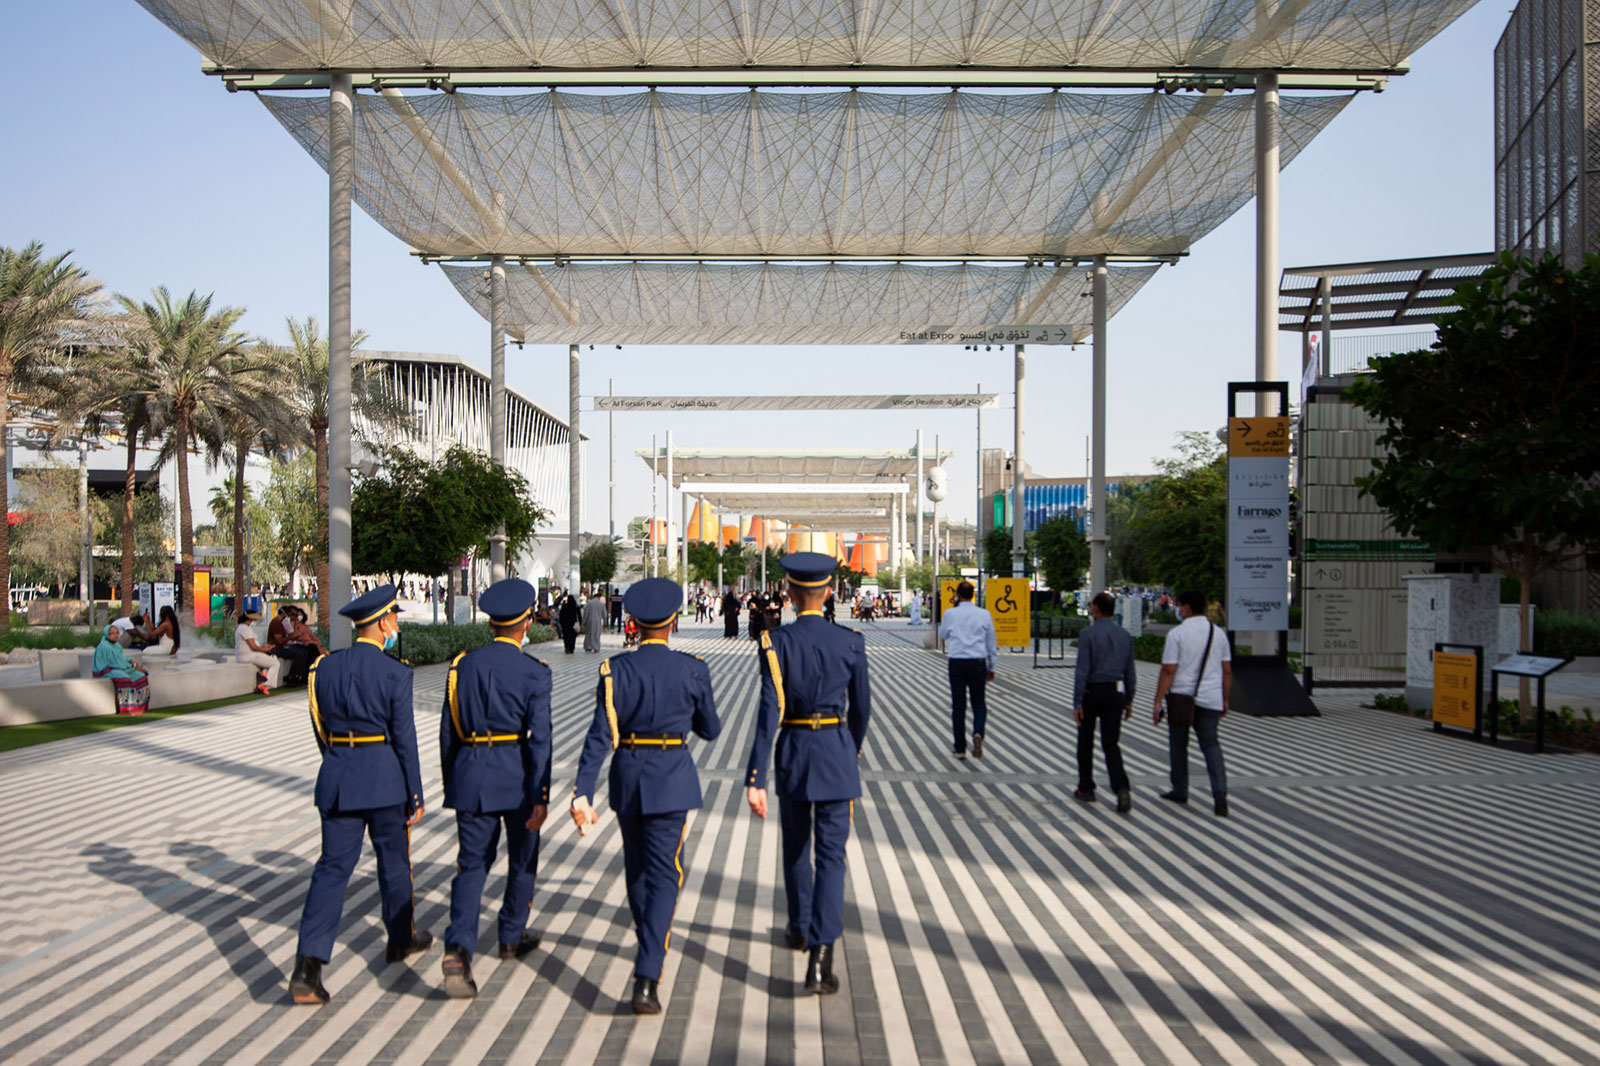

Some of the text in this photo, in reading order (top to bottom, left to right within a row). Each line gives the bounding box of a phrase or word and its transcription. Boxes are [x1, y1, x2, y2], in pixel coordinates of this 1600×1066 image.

[900, 331, 954, 343] Eat at Expo
[959, 331, 987, 341] إكسبو
[988, 331, 1005, 343] في
[612, 399, 662, 407] Al Forsan Park
[916, 398, 944, 406] Pavilion
[1238, 505, 1282, 519] Farrago
